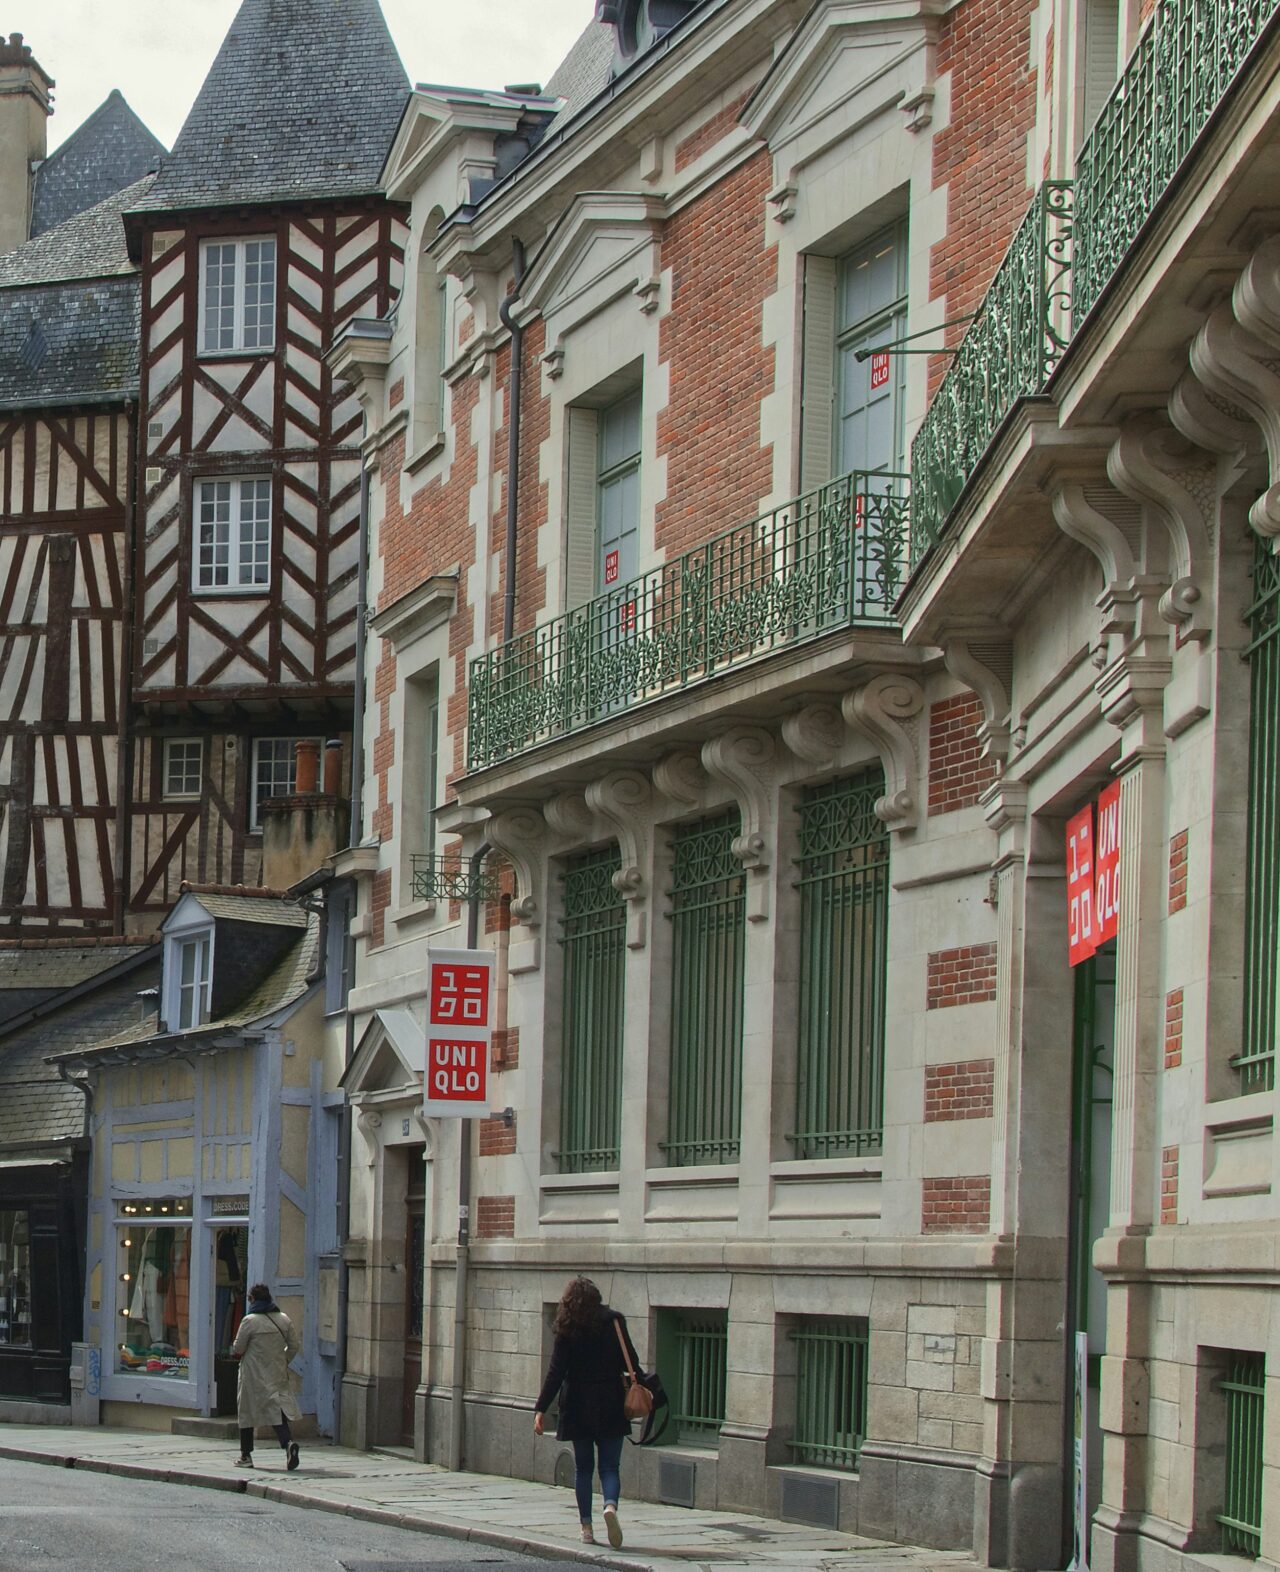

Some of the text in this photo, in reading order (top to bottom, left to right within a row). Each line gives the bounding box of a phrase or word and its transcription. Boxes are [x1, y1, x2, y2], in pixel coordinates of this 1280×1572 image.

[873, 354, 887, 370] UNI
[873, 366, 888, 386] QLO
[606, 567, 617, 581] QLO
[439, 972, 482, 992] ユニ
[437, 997, 481, 1018] クロ
[435, 1045, 476, 1067] UNI
[434, 1070, 480, 1094] QLO
[160, 1356, 190, 1367] DRESS.COD
